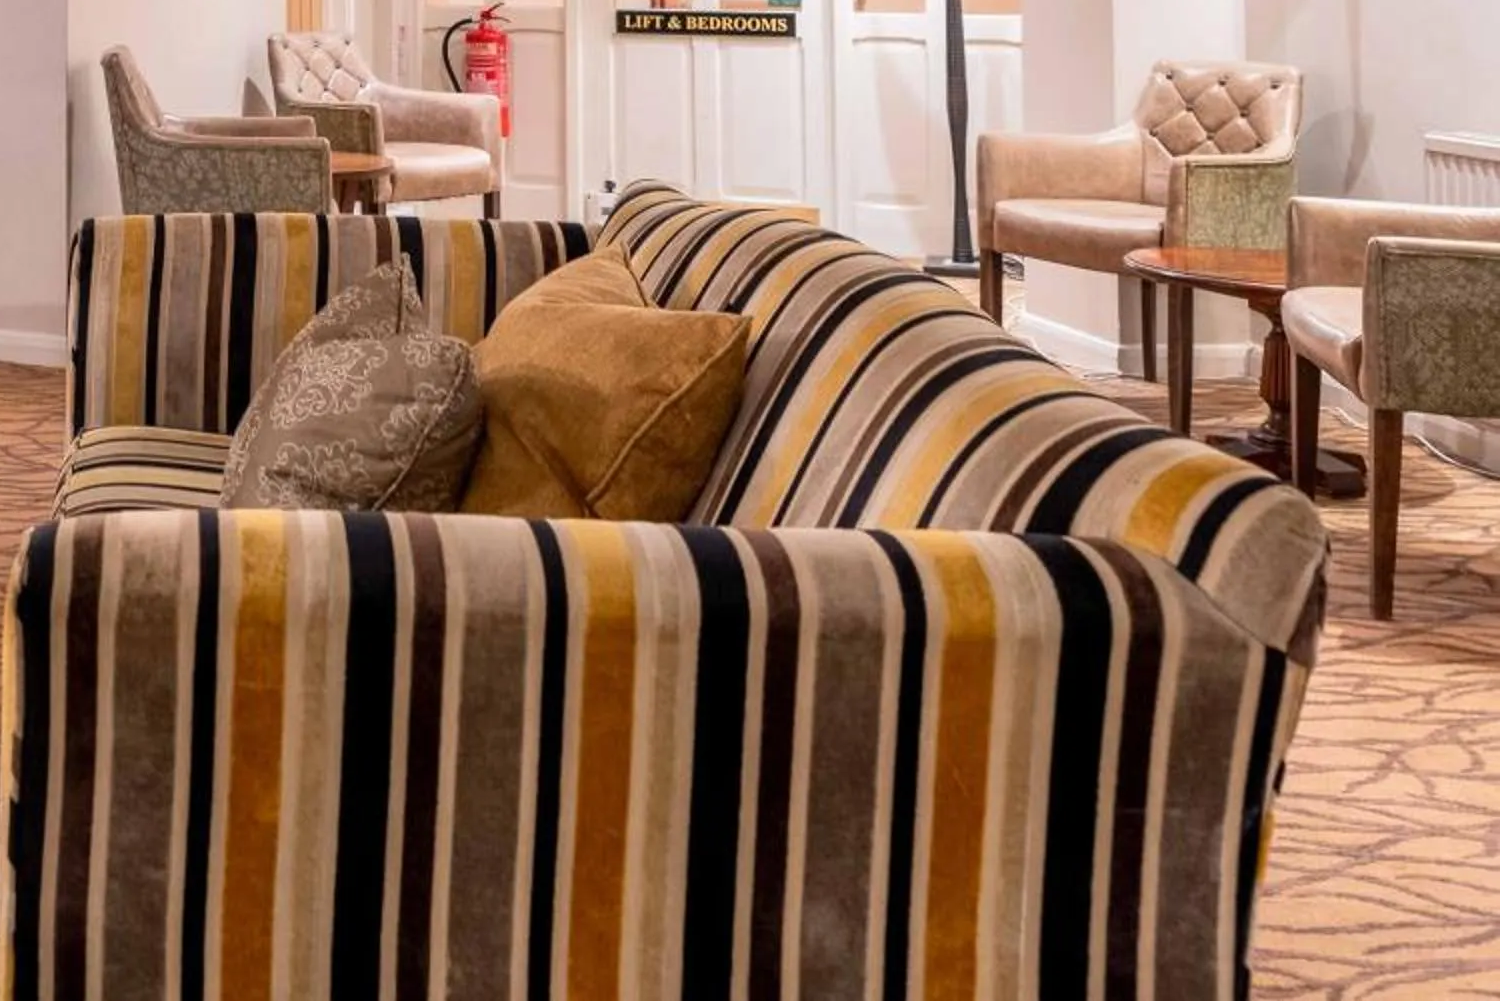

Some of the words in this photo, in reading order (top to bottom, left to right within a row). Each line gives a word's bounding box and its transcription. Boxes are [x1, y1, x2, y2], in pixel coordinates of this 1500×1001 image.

[624, 15, 664, 29] LIFT
[667, 15, 682, 29] &
[686, 15, 788, 32] BEDROOMS
